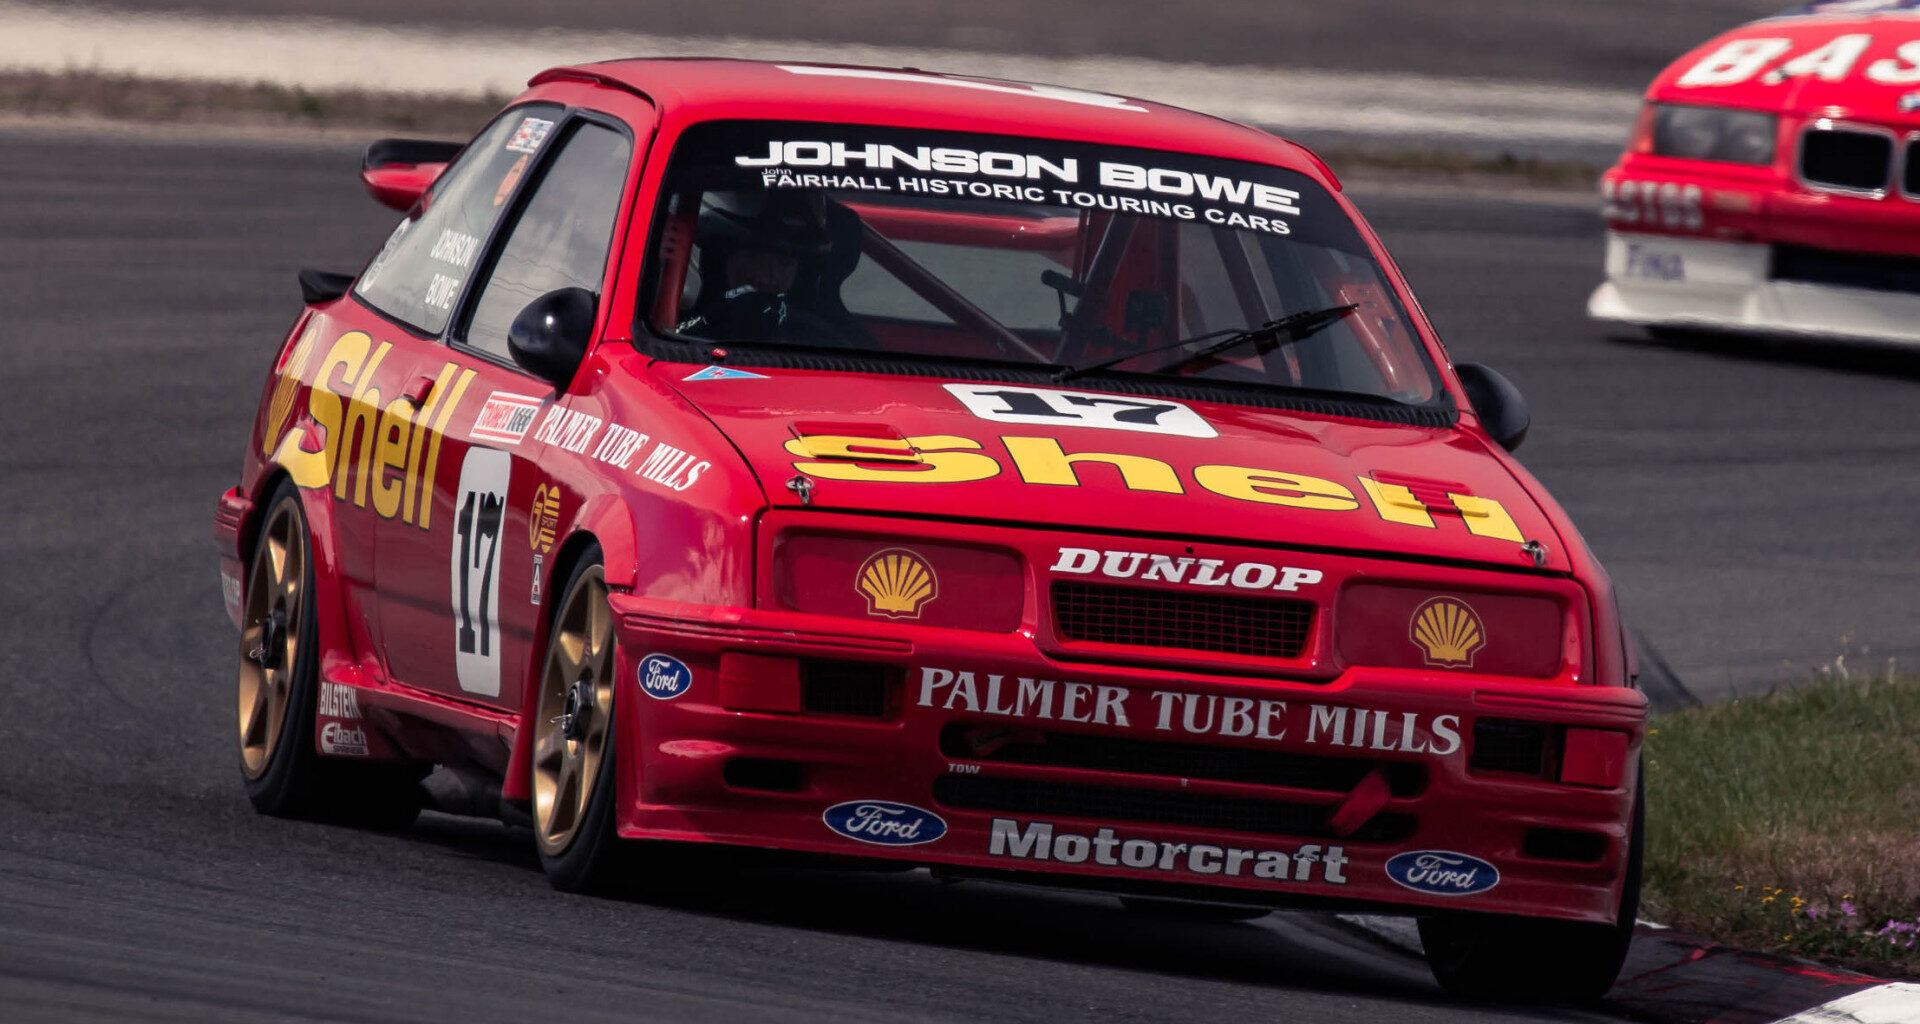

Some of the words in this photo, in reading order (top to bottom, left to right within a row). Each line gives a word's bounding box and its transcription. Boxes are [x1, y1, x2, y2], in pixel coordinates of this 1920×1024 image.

[735, 140, 1077, 183] JOHNSON
[1100, 160, 1300, 215] BOWE
[763, 174, 891, 190] FAIRHALL
[899, 177, 1045, 201] HISTORIC
[1053, 189, 1200, 218] TOURING
[1205, 208, 1290, 235] CARS
[430, 229, 479, 267] JOHNSON
[425, 273, 459, 309] BOWE
[972, 388, 1178, 426] 17
[272, 331, 478, 532] Shell
[534, 405, 603, 459] PALMER
[592, 422, 650, 469] TUBE
[636, 442, 711, 492] MILLS
[783, 434, 1528, 543] Shell
[457, 490, 505, 657] 17
[1050, 547, 1324, 592] DUNLOP
[645, 658, 680, 692] Ford
[319, 682, 362, 718] BILSTEIN
[917, 667, 1130, 728] PALMER
[1150, 689, 1287, 743] TUBE
[1304, 703, 1462, 755] MILLS
[320, 722, 367, 753] Eibach
[948, 763, 981, 774] TOW
[843, 800, 923, 842] Ford
[989, 817, 1348, 885] Motorcraft
[1406, 853, 1479, 889] Ford
